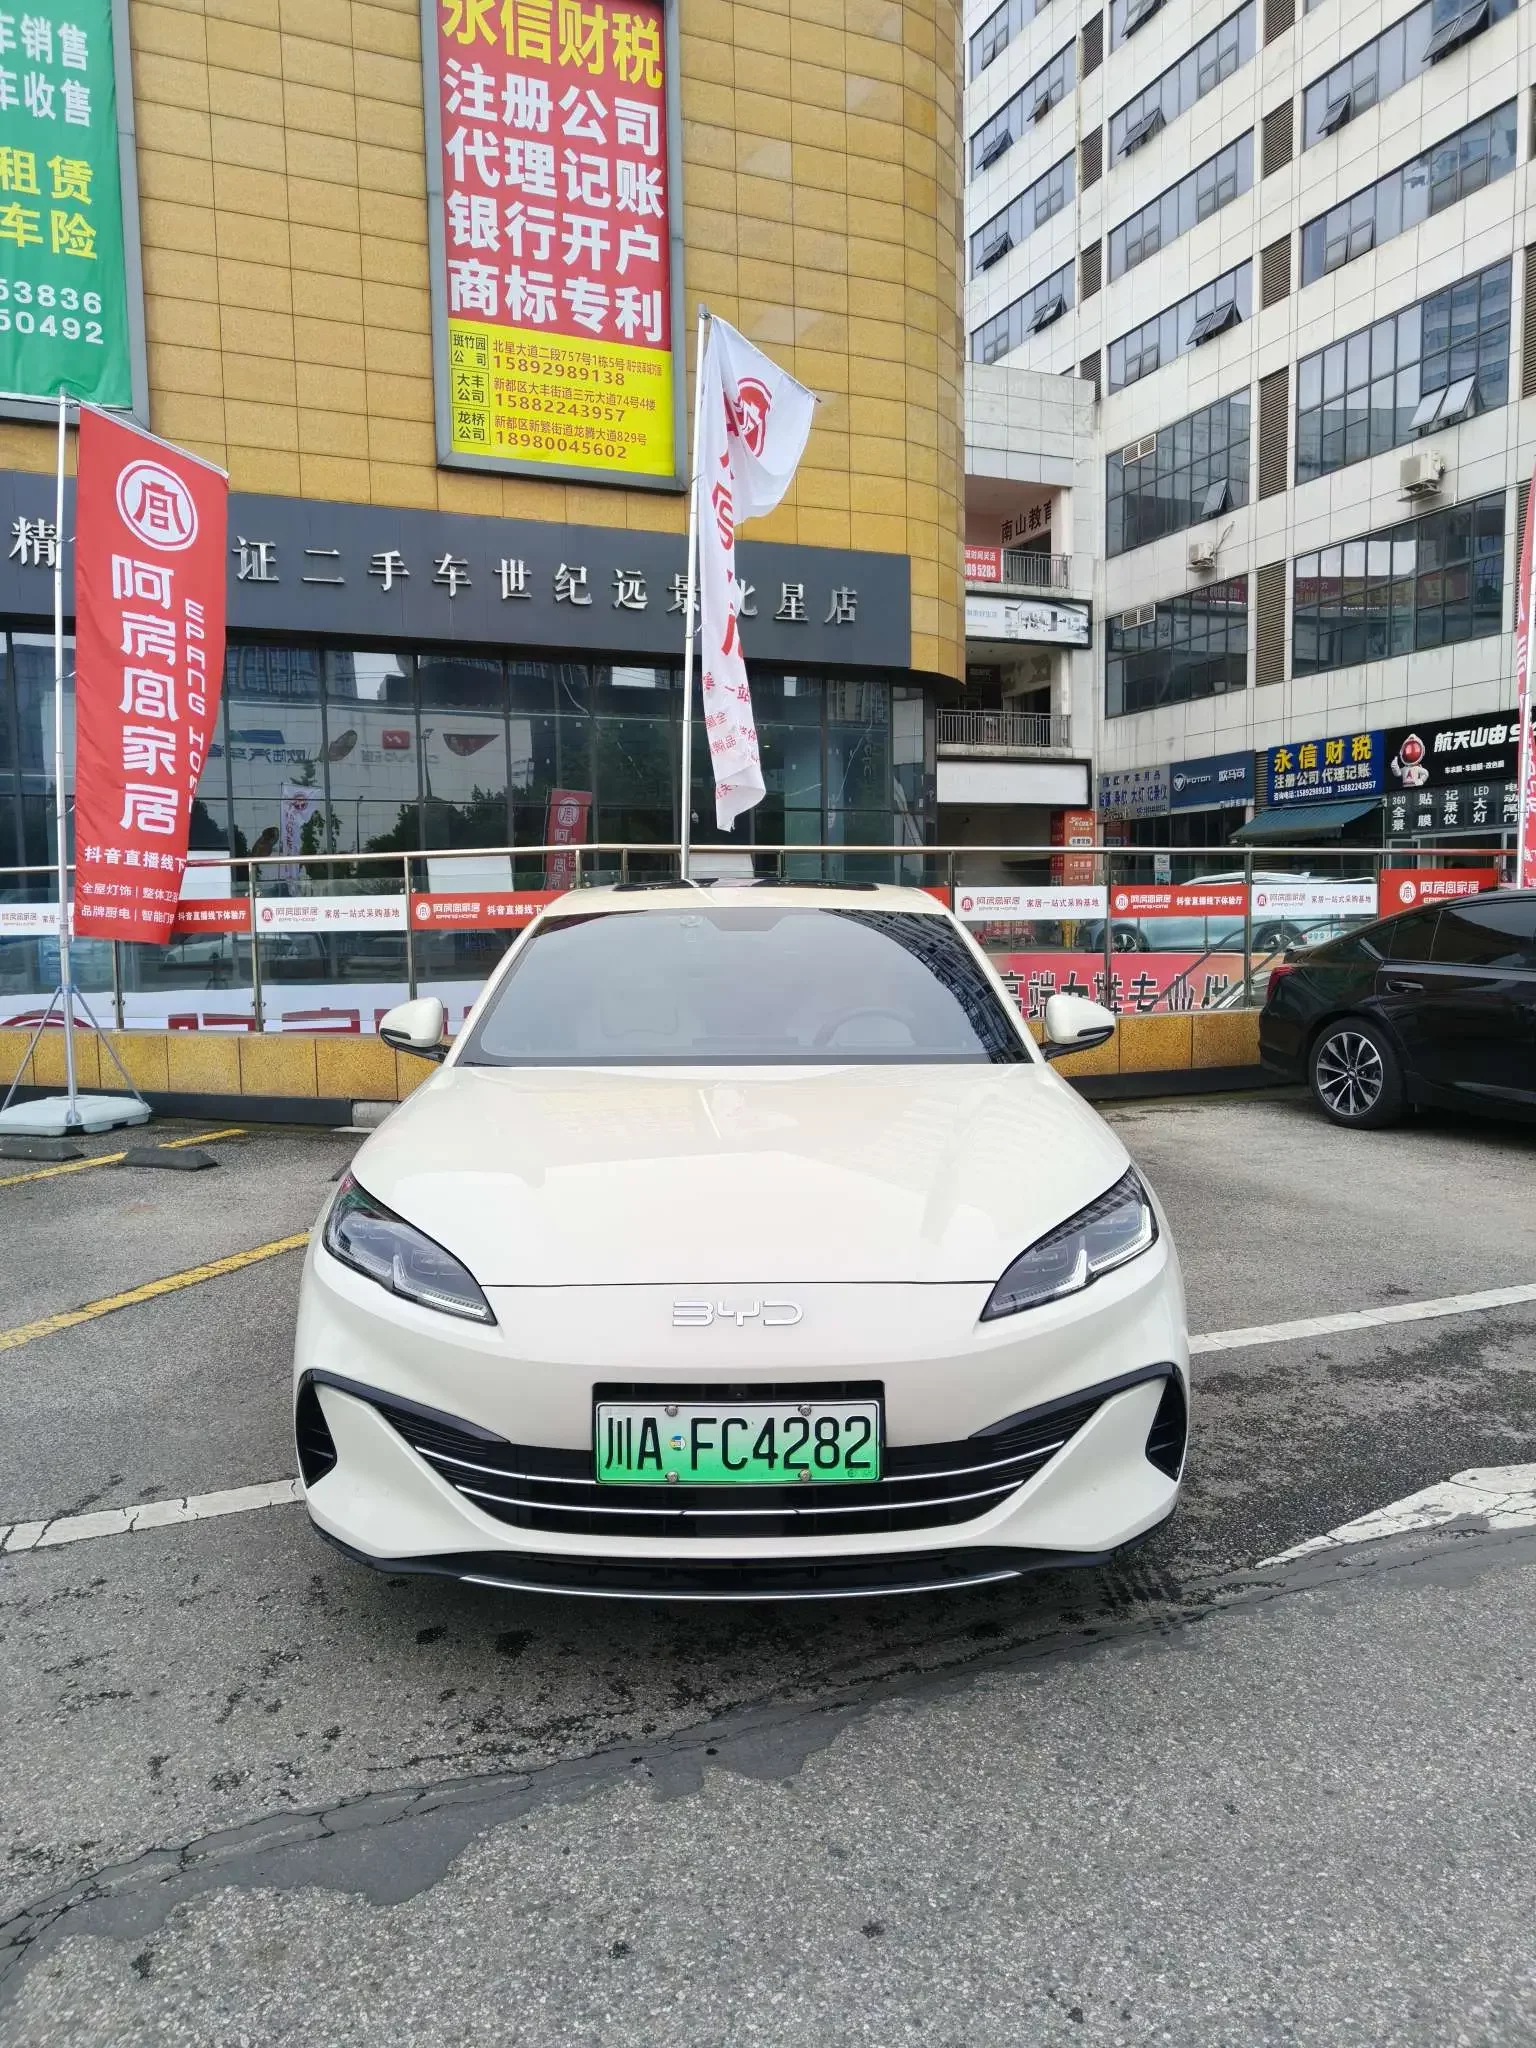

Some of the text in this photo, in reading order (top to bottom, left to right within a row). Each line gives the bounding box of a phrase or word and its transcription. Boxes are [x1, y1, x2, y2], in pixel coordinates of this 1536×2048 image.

[441, 0, 663, 89] 永信财税
[443, 58, 660, 156] 注册公司
[445, 126, 665, 219] 代理记账
[446, 190, 661, 276] 银行开户
[447, 258, 662, 342] 商标专利
[453, 334, 486, 351] 斑竹园
[457, 373, 485, 388] 大丰
[493, 355, 625, 386] 15892989138
[457, 388, 485, 403] 公司
[495, 393, 626, 422] 15882243957
[458, 411, 485, 426] 龙桥
[459, 426, 485, 441] 公司
[496, 431, 627, 459] 18980045602
[1274, 734, 1373, 773] 永信财税
[1218, 767, 1246, 782] 欧马可
[1274, 762, 1372, 790] 注册公司 代理记账
[1418, 793, 1433, 827] 贴膜
[1444, 790, 1459, 825] 记录仪
[82, 882, 132, 897] 全屋灯饰
[81, 905, 131, 920] 品牌厨电
[176, 910, 247, 922] 抖音直播线下体验厅
[324, 908, 400, 919] 家居一站式采购基地
[672, 1300, 804, 1327] BYD
[690, 1415, 871, 1471] FC4282
